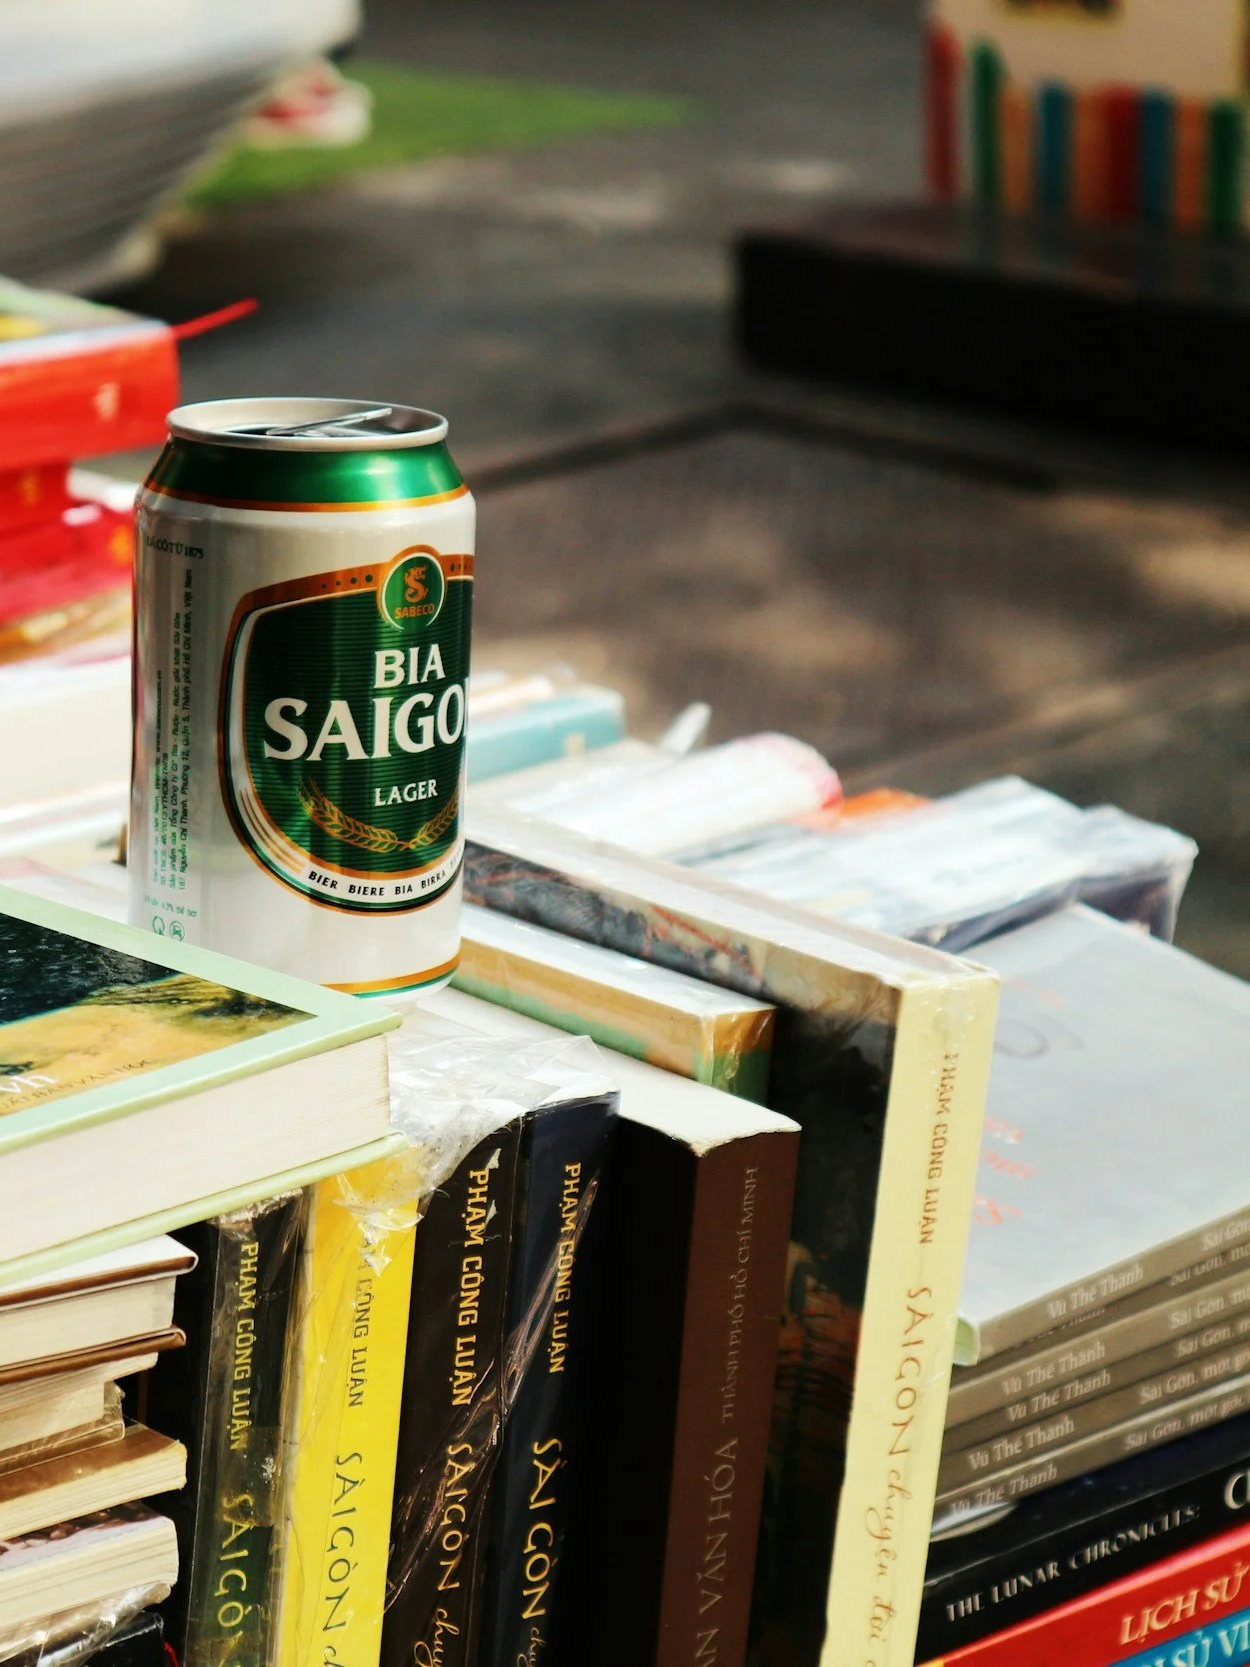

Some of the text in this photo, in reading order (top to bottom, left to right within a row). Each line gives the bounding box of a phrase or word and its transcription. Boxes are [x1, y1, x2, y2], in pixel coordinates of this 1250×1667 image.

[394, 603, 435, 619] SABECO
[374, 643, 446, 689] BIA
[263, 677, 470, 762] SAIGO
[374, 779, 438, 807] LAGER
[308, 870, 446, 897] BIER BIERE BIA BIRRA
[560, 1162, 581, 1234] PHẠM
[741, 1166, 759, 1226] MINH
[235, 1241, 259, 1311] PHẠM
[736, 1229, 752, 1264] CHÍ
[451, 1168, 490, 1407] PHẠM CÔNG LUẬN
[232, 1318, 258, 1381] CÔNG
[547, 1308, 570, 1373] LUẬN
[346, 1346, 367, 1407] LUẬN
[946, 1594, 985, 1623] THE
[991, 1560, 1061, 1604] LUNAR
[1119, 1588, 1199, 1646] LỊCH
